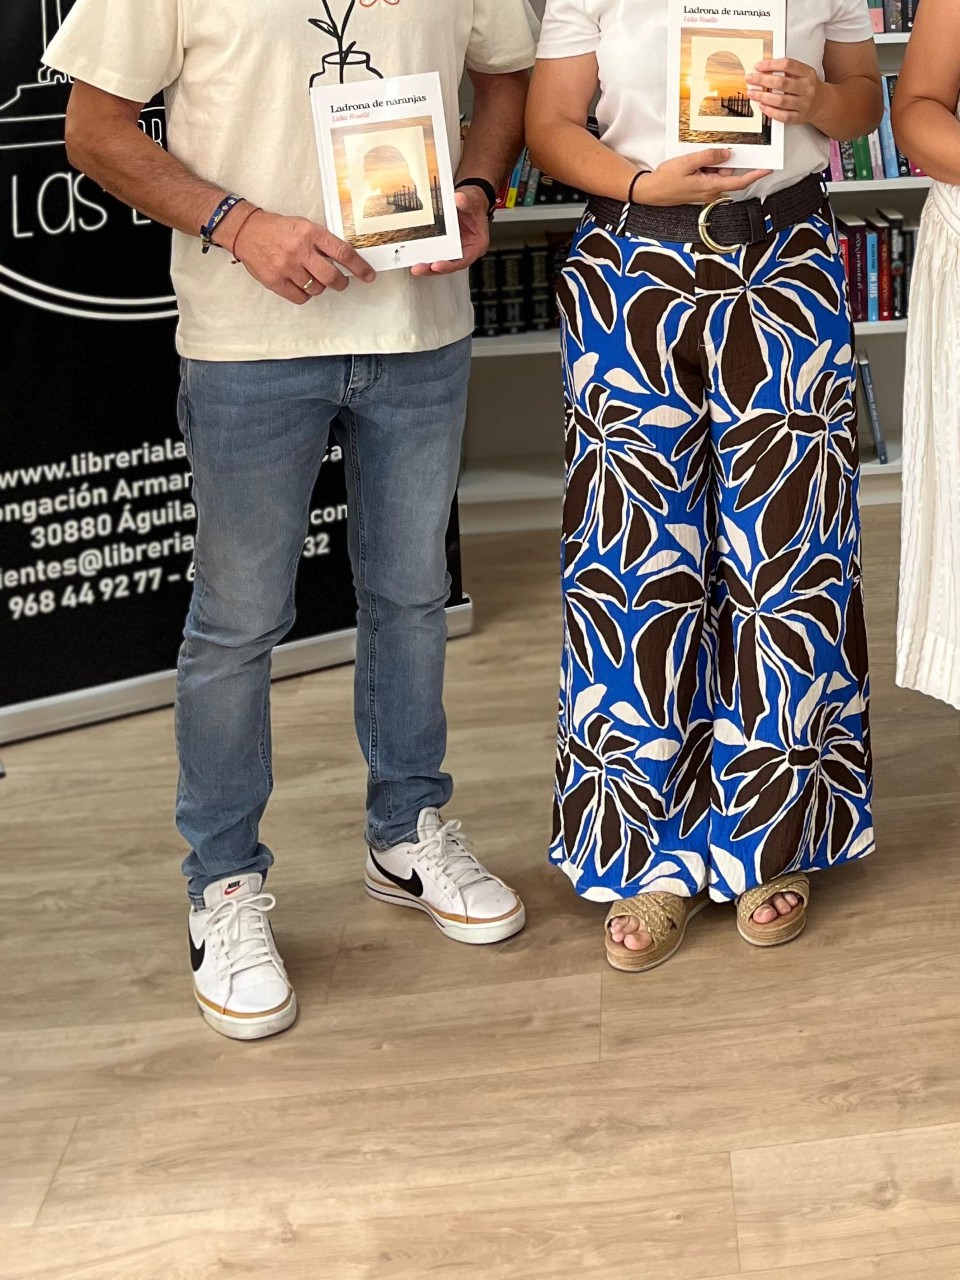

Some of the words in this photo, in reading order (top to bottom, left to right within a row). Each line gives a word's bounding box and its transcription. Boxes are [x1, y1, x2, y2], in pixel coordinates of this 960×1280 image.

[683, 6, 720, 15] Ladrona
[721, 7, 732, 15] de
[733, 9, 771, 18] naranjas
[330, 100, 371, 114] Ladrona
[373, 99, 384, 108] de
[386, 94, 427, 107] naranjas
[869, 272, 878, 283] ME
[869, 284, 878, 298] SAVE
[30, 513, 112, 549] 30880
[117, 503, 197, 534] Águila
[8, 589, 56, 620] 968
[61, 581, 95, 608] 44
[99, 574, 130, 601] 92
[133, 567, 163, 593] 77
